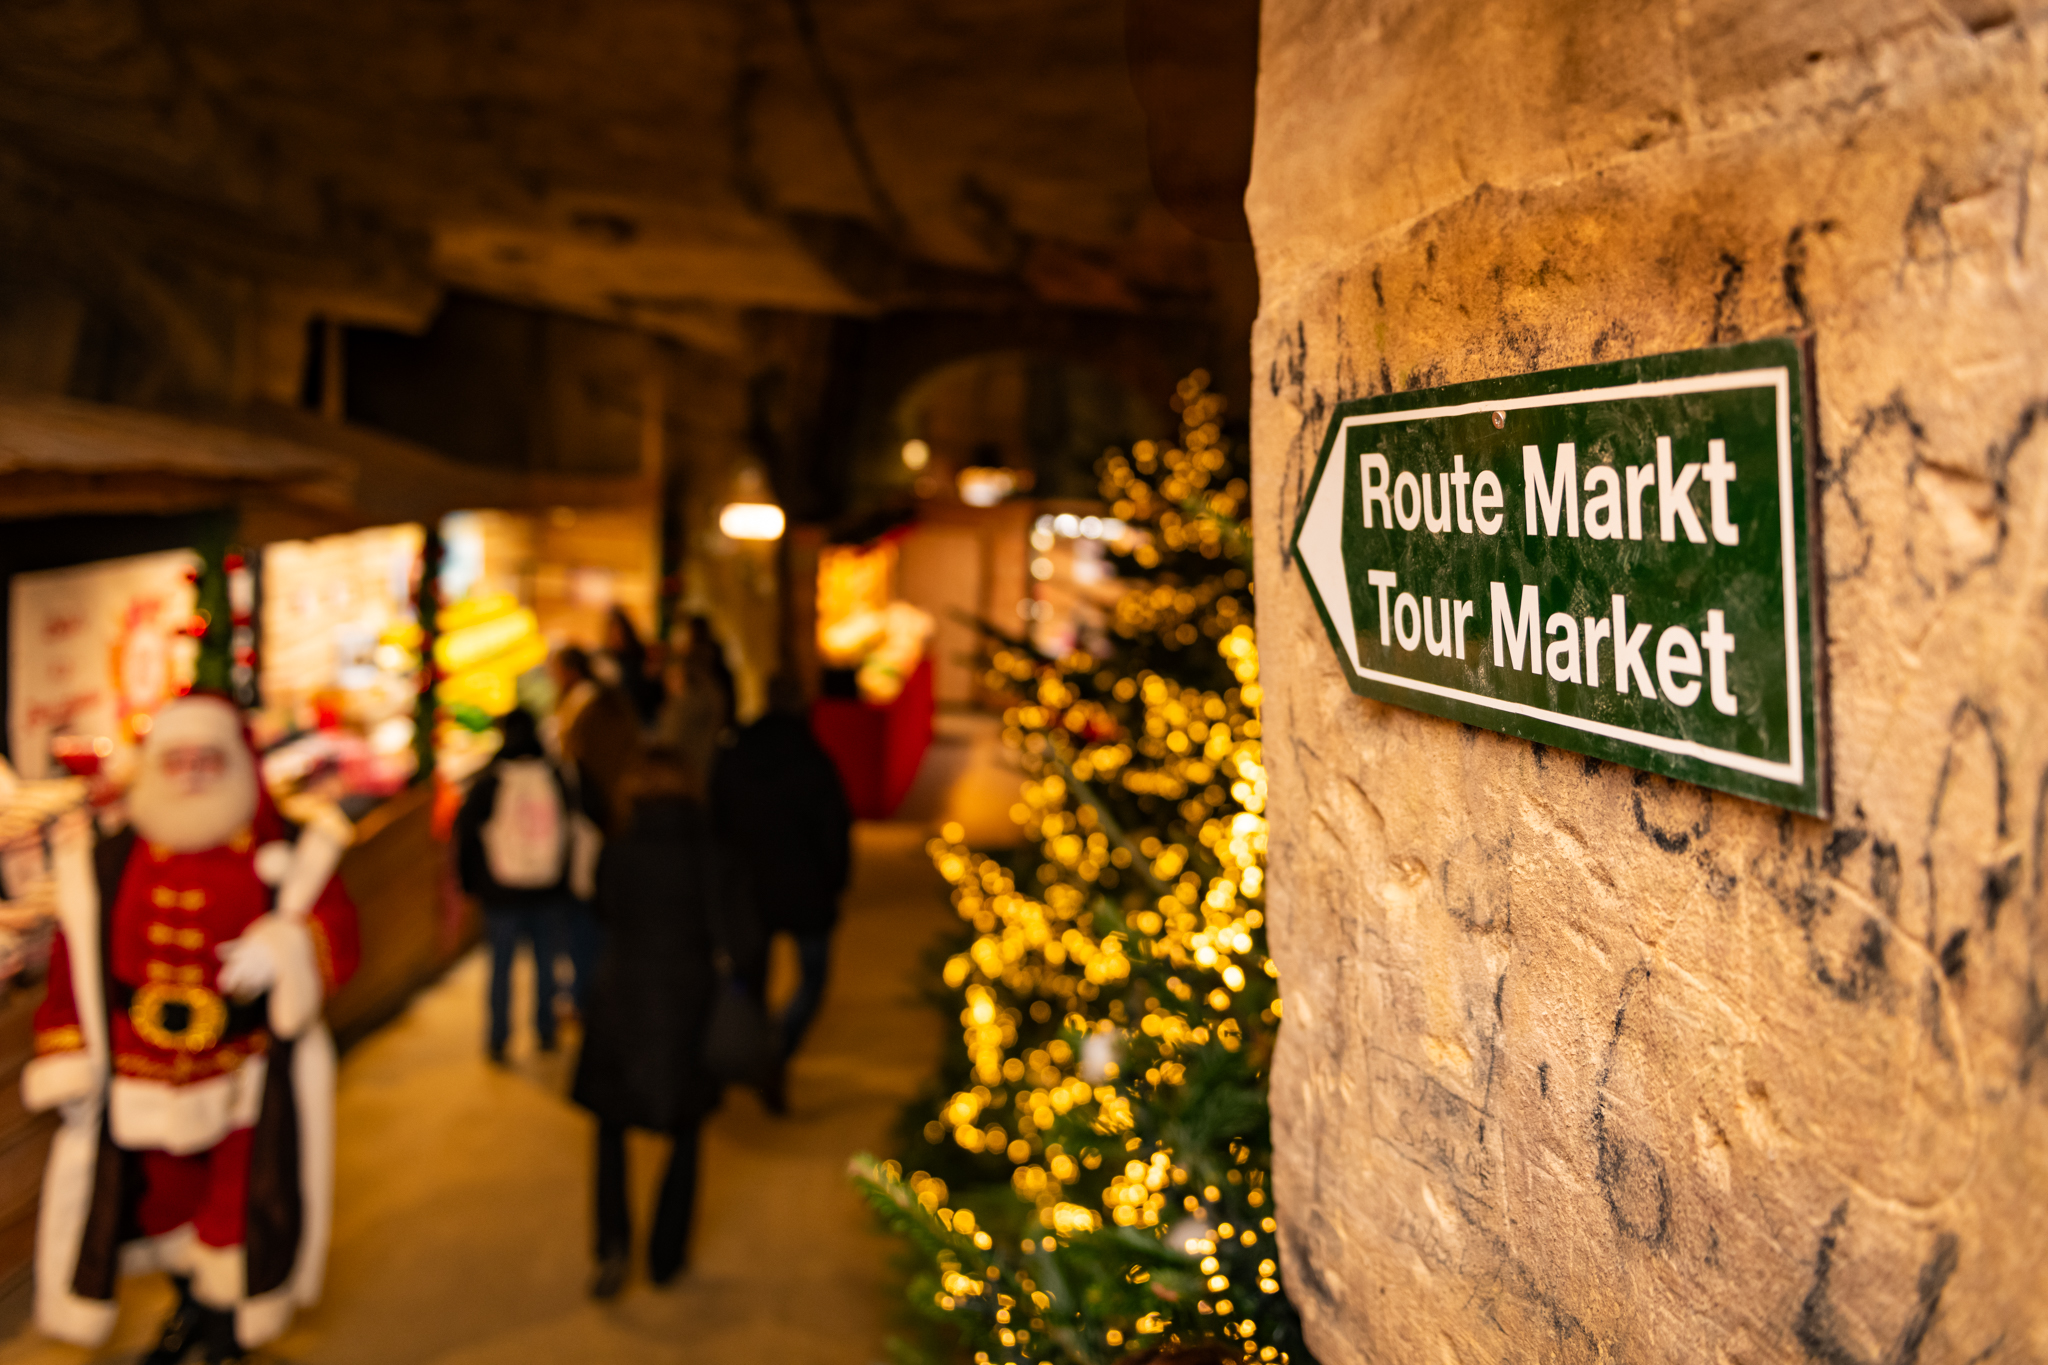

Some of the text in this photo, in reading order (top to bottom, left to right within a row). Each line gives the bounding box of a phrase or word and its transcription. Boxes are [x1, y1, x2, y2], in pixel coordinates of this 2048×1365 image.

[1359, 453, 1504, 536] Route
[1522, 436, 1739, 546] Markt
[1368, 570, 1738, 716] Tour Market
